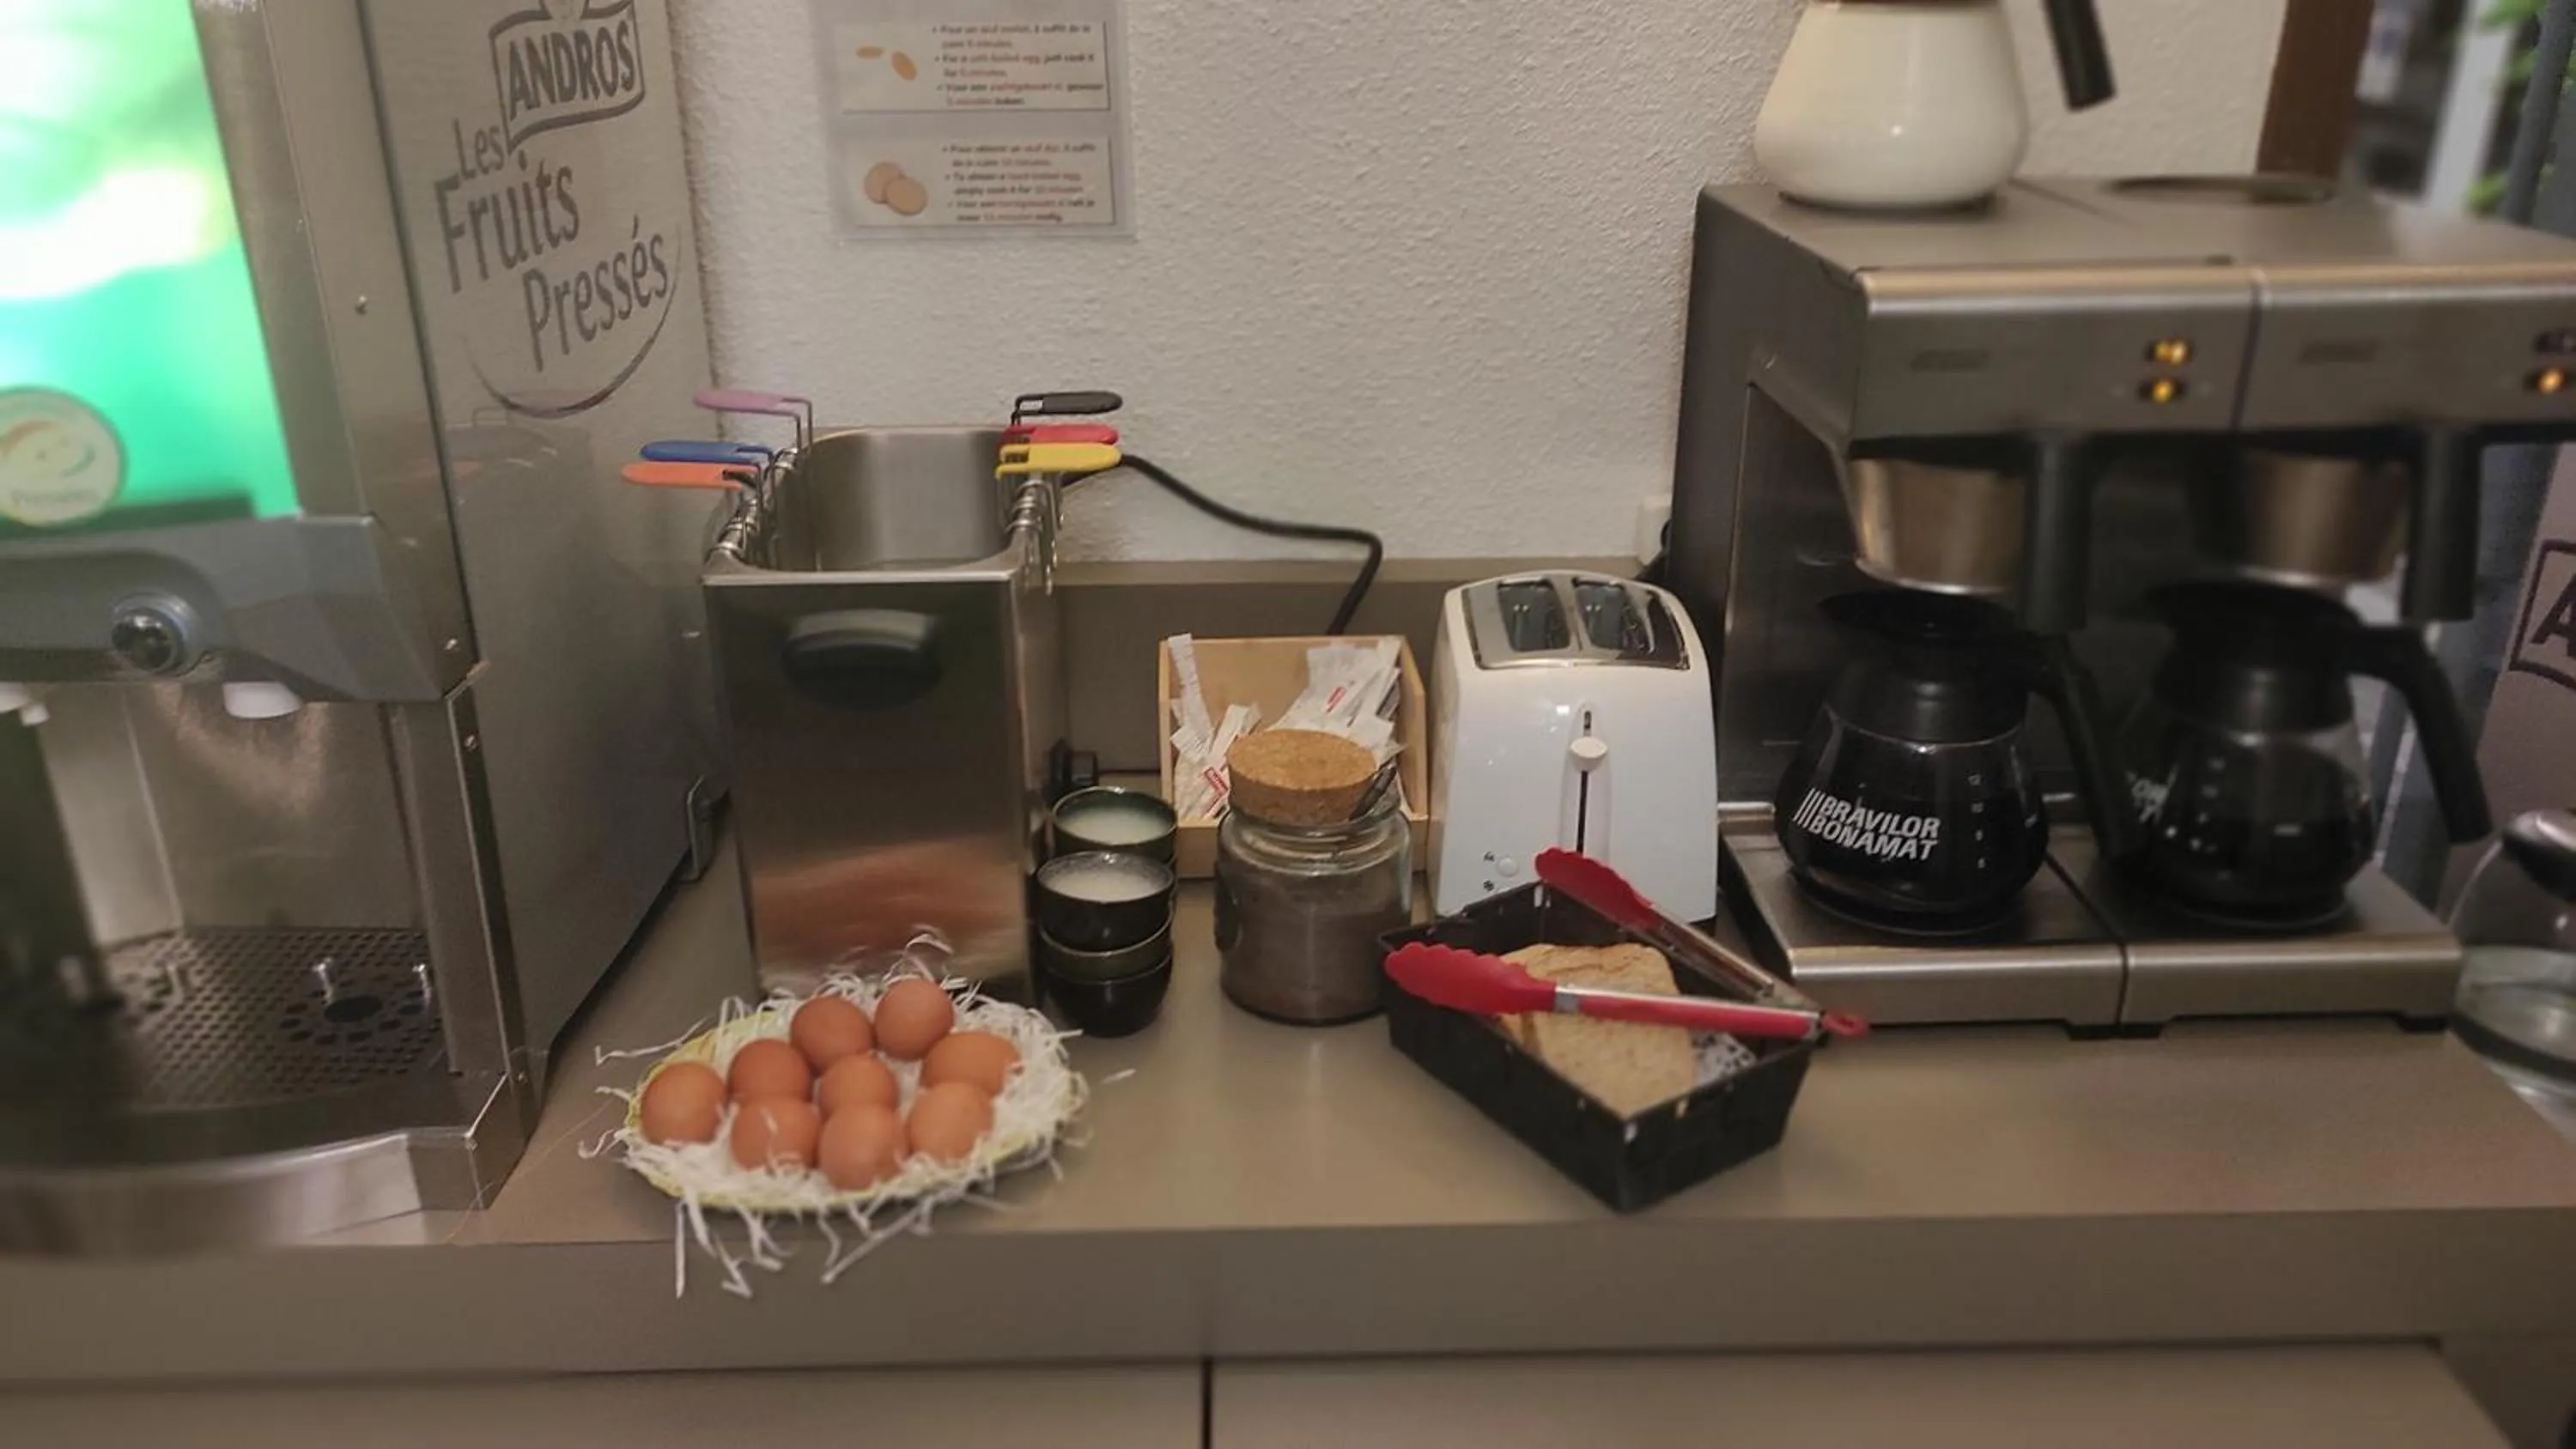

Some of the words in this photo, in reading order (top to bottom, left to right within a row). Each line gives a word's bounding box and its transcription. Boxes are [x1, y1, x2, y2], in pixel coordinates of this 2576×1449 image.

[508, 20, 635, 121] ANDROS
[453, 118, 505, 180] Les
[434, 149, 580, 294] Fruits
[523, 215, 669, 373] Pressés
[1807, 815, 1940, 861] BONAMAT
[1819, 795, 1941, 839] BRAVILOR
